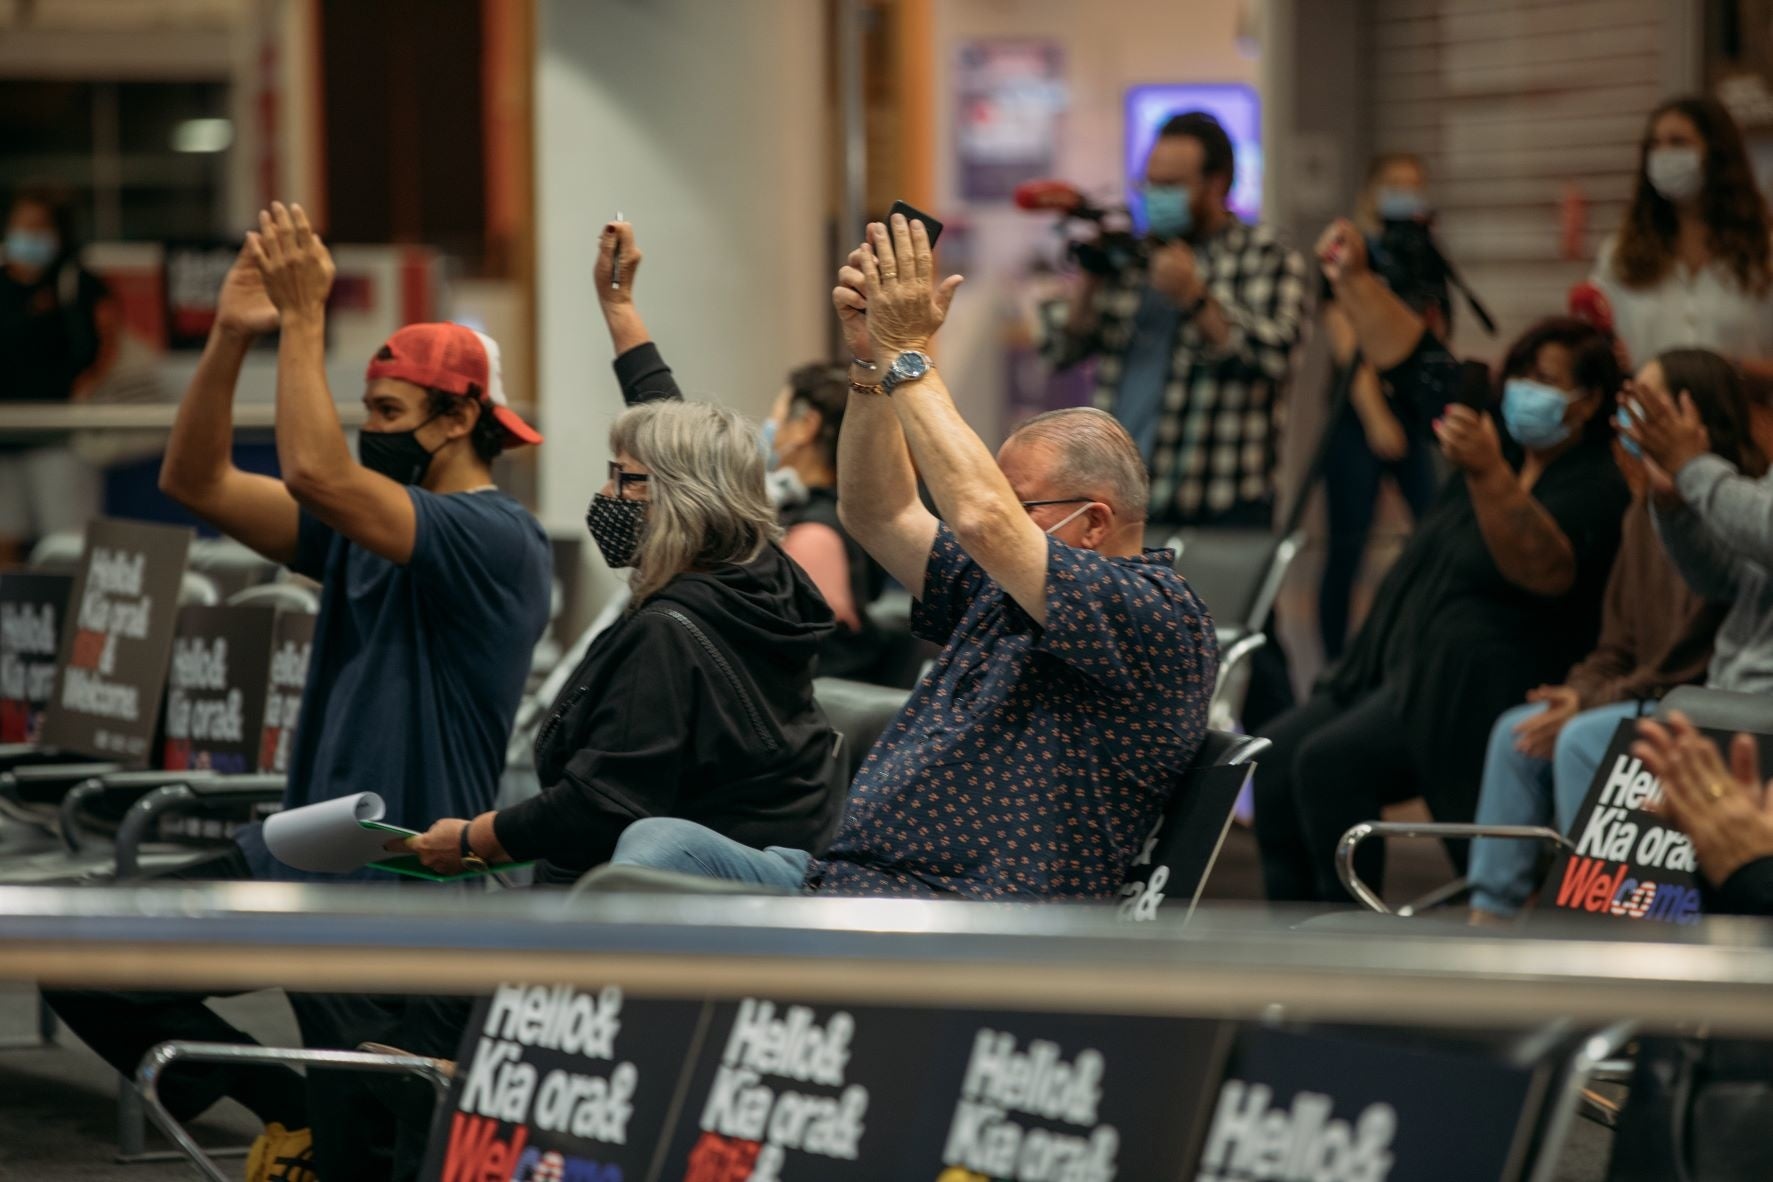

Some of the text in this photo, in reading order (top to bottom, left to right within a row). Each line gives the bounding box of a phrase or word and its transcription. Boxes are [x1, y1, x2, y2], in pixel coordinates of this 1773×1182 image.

[1575, 805, 1698, 873] Kia ora
[483, 982, 623, 1061] Hello&
[722, 996, 855, 1086] Hello&
[459, 1036, 638, 1145] Kia ora&
[700, 1064, 870, 1160] Kia ora&
[961, 1027, 1105, 1127] Hello&
[942, 1098, 1024, 1179] Kia
[1201, 1077, 1399, 1182] Hello&
